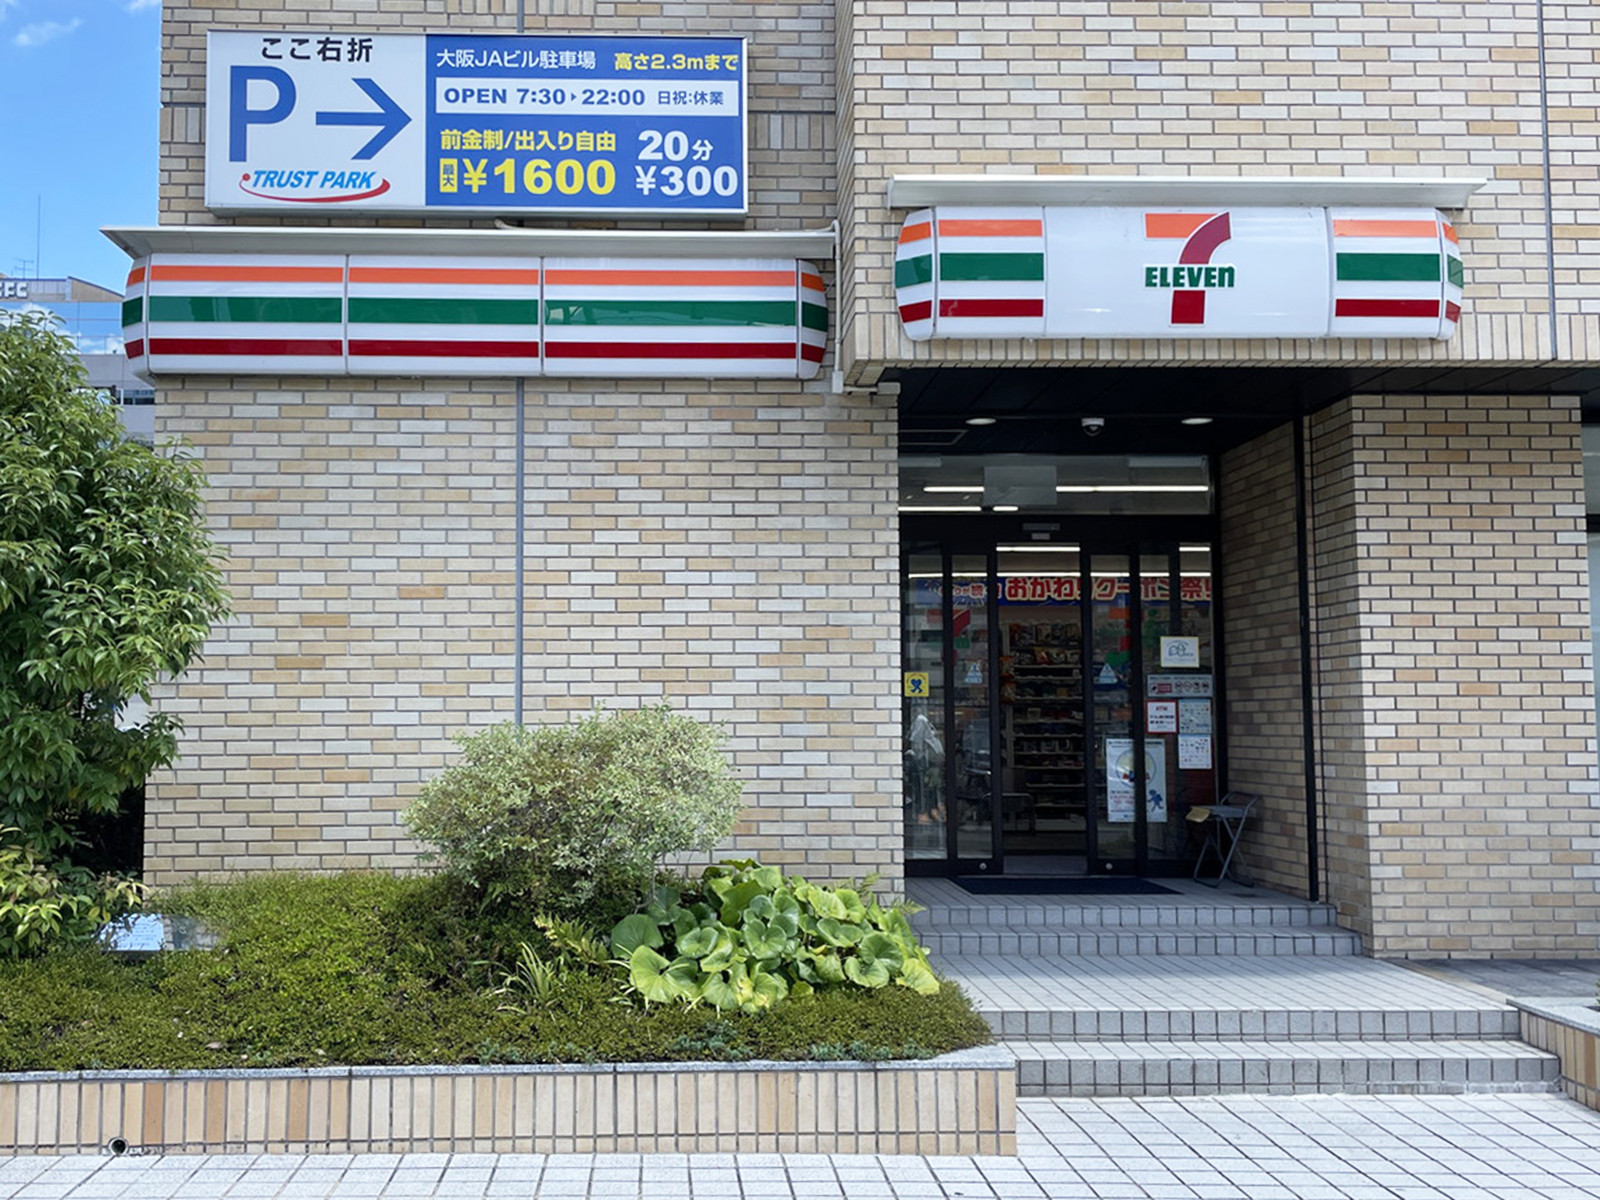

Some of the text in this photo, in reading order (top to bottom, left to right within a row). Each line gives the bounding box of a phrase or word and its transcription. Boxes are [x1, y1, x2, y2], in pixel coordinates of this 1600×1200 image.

[261, 37, 373, 63] ここ右折
[436, 49, 739, 71] 大阪JAビル駐車場 高さ2.3mまで
[444, 88, 724, 106] OPEN 7:30 22:00 日祝:休業
[229, 65, 297, 162] P
[440, 129, 616, 152] 前金制/出入り自由
[638, 130, 714, 161] 20分
[252, 170, 376, 189] TRUST PARK
[462, 158, 616, 195] ¥1600
[634, 165, 738, 197] ¥300
[1145, 212, 1232, 324] 7
